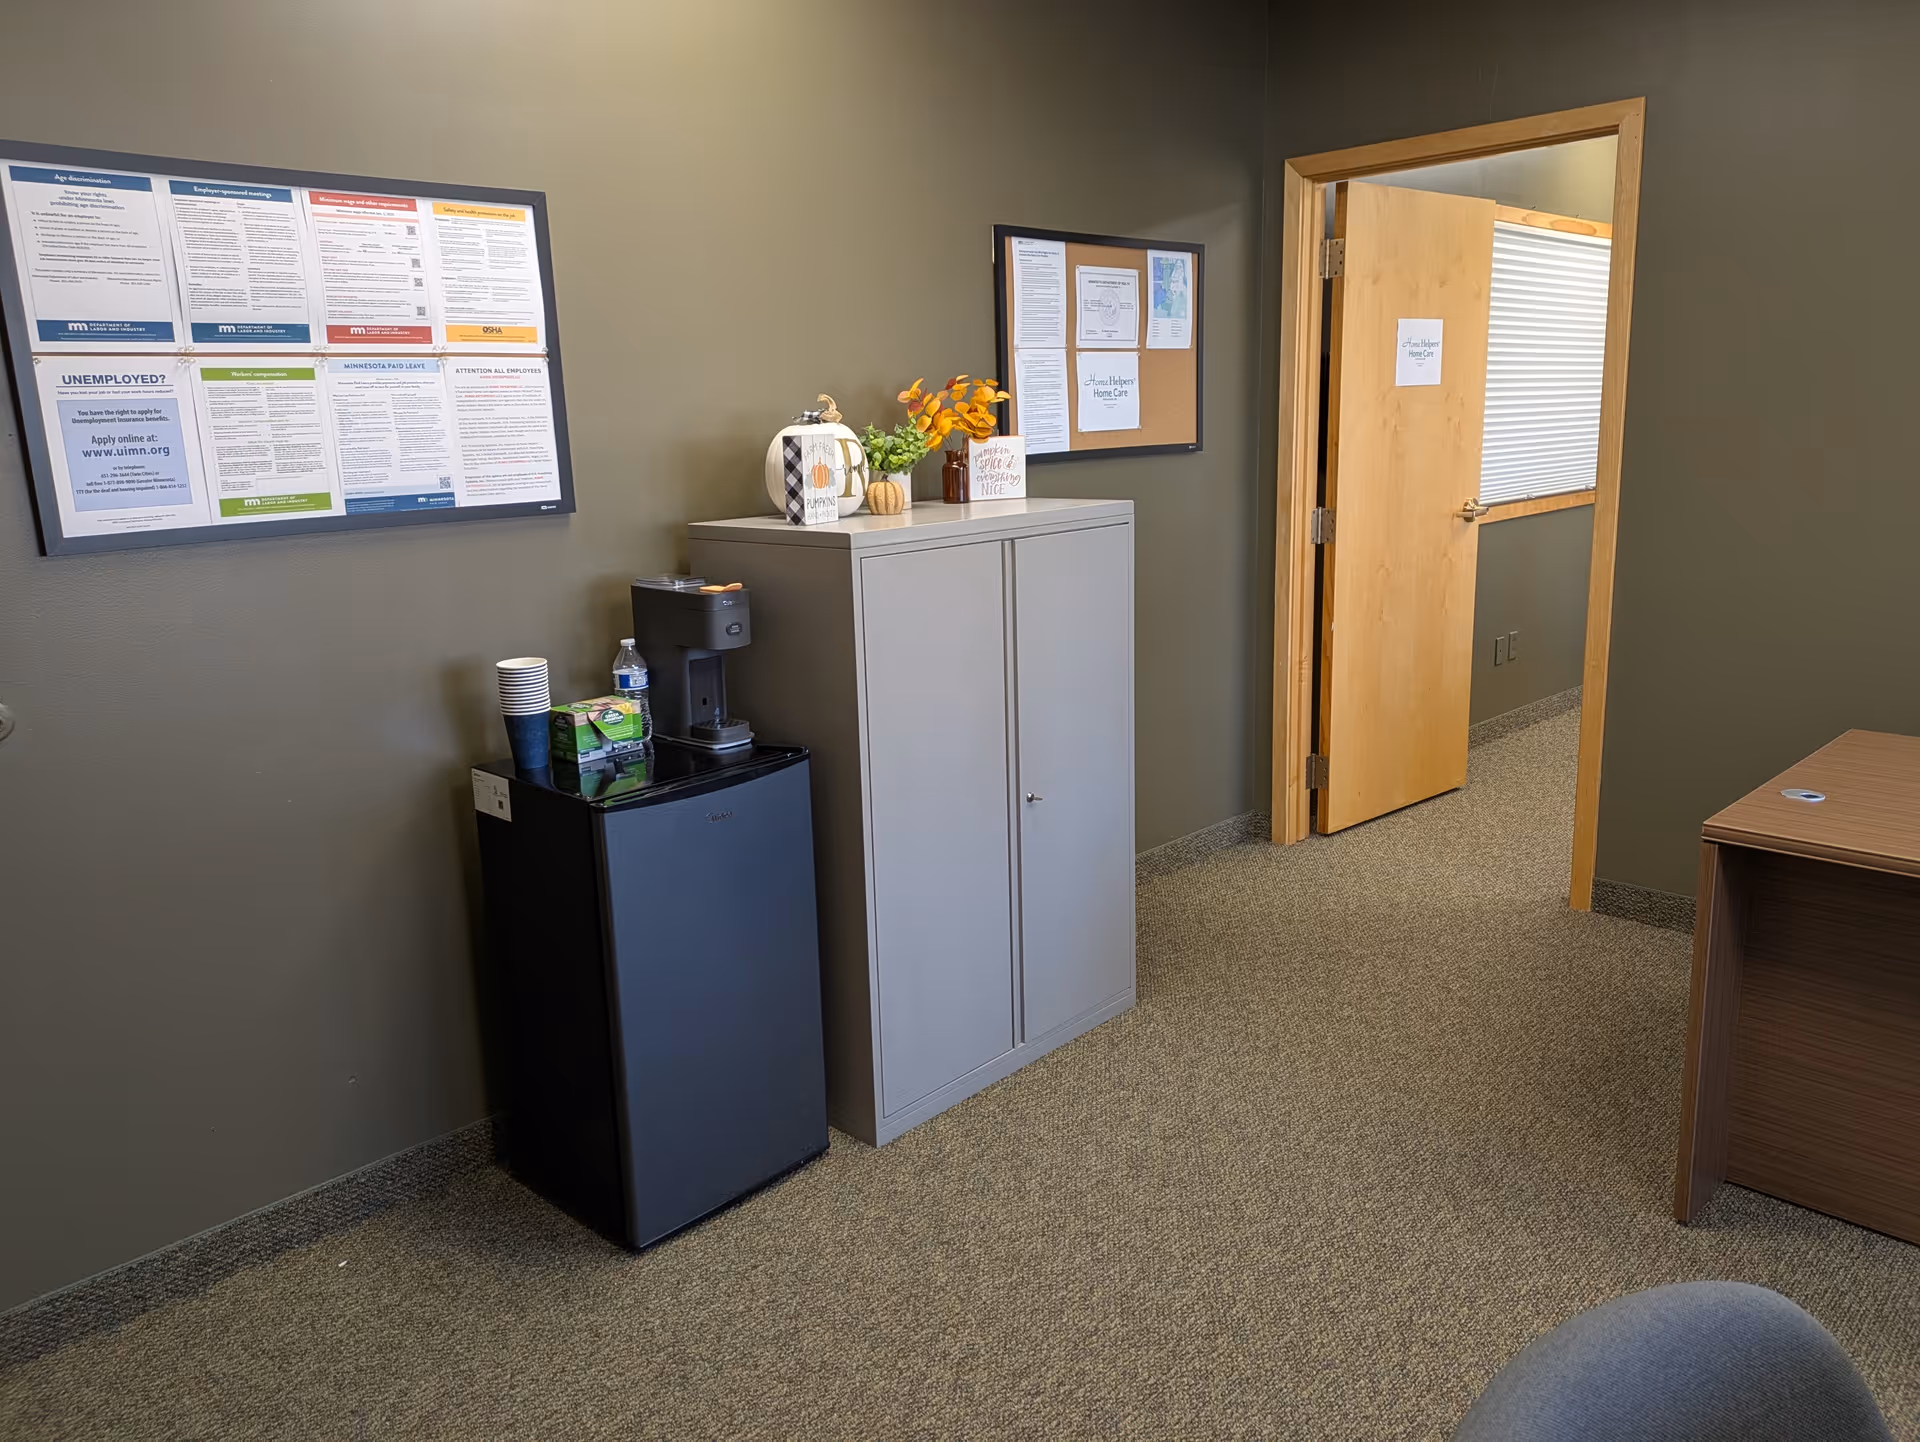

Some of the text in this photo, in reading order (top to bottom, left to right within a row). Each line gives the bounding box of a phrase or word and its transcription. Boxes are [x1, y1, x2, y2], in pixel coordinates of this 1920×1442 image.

[55, 174, 111, 184] Age discrimination
[193, 186, 272, 199] Employer-sponsored meetings
[482, 326, 503, 334] OSHA
[1402, 337, 1421, 348] Home
[62, 374, 166, 385] UNEMPLOYED?
[1084, 373, 1108, 386] Home
[1094, 388, 1128, 398] Home Care
[138, 408, 153, 416] apply
[91, 434, 158, 446] Apply online at:
[82, 446, 170, 458] www.uimn.org
[804, 443, 817, 460] FARM
[974, 443, 1010, 467] pumpkin
[979, 456, 1002, 470] spice
[976, 470, 1021, 486] everything
[807, 496, 836, 509] PUMPKINS
